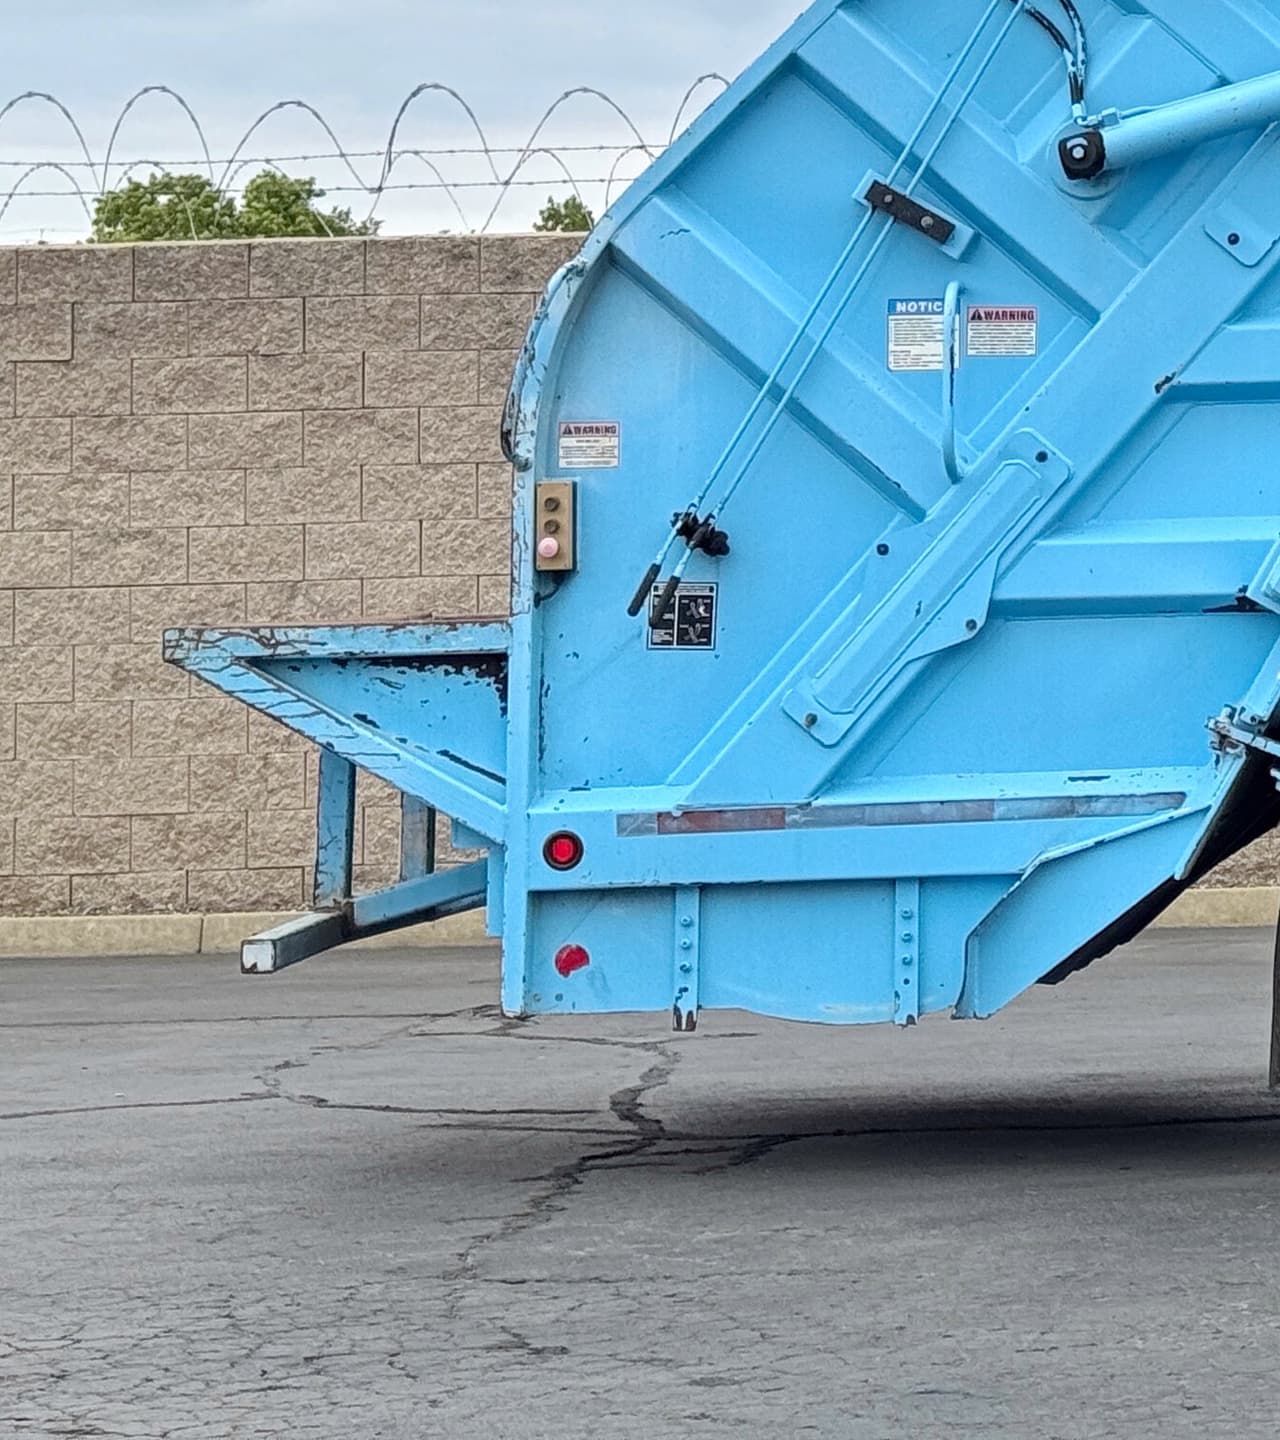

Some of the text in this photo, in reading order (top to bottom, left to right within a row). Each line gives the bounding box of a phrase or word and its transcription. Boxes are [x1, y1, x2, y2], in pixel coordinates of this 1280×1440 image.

[896, 301, 944, 312] NOTIC
[984, 310, 1034, 320] WARNING
[573, 425, 617, 435] WARNING
